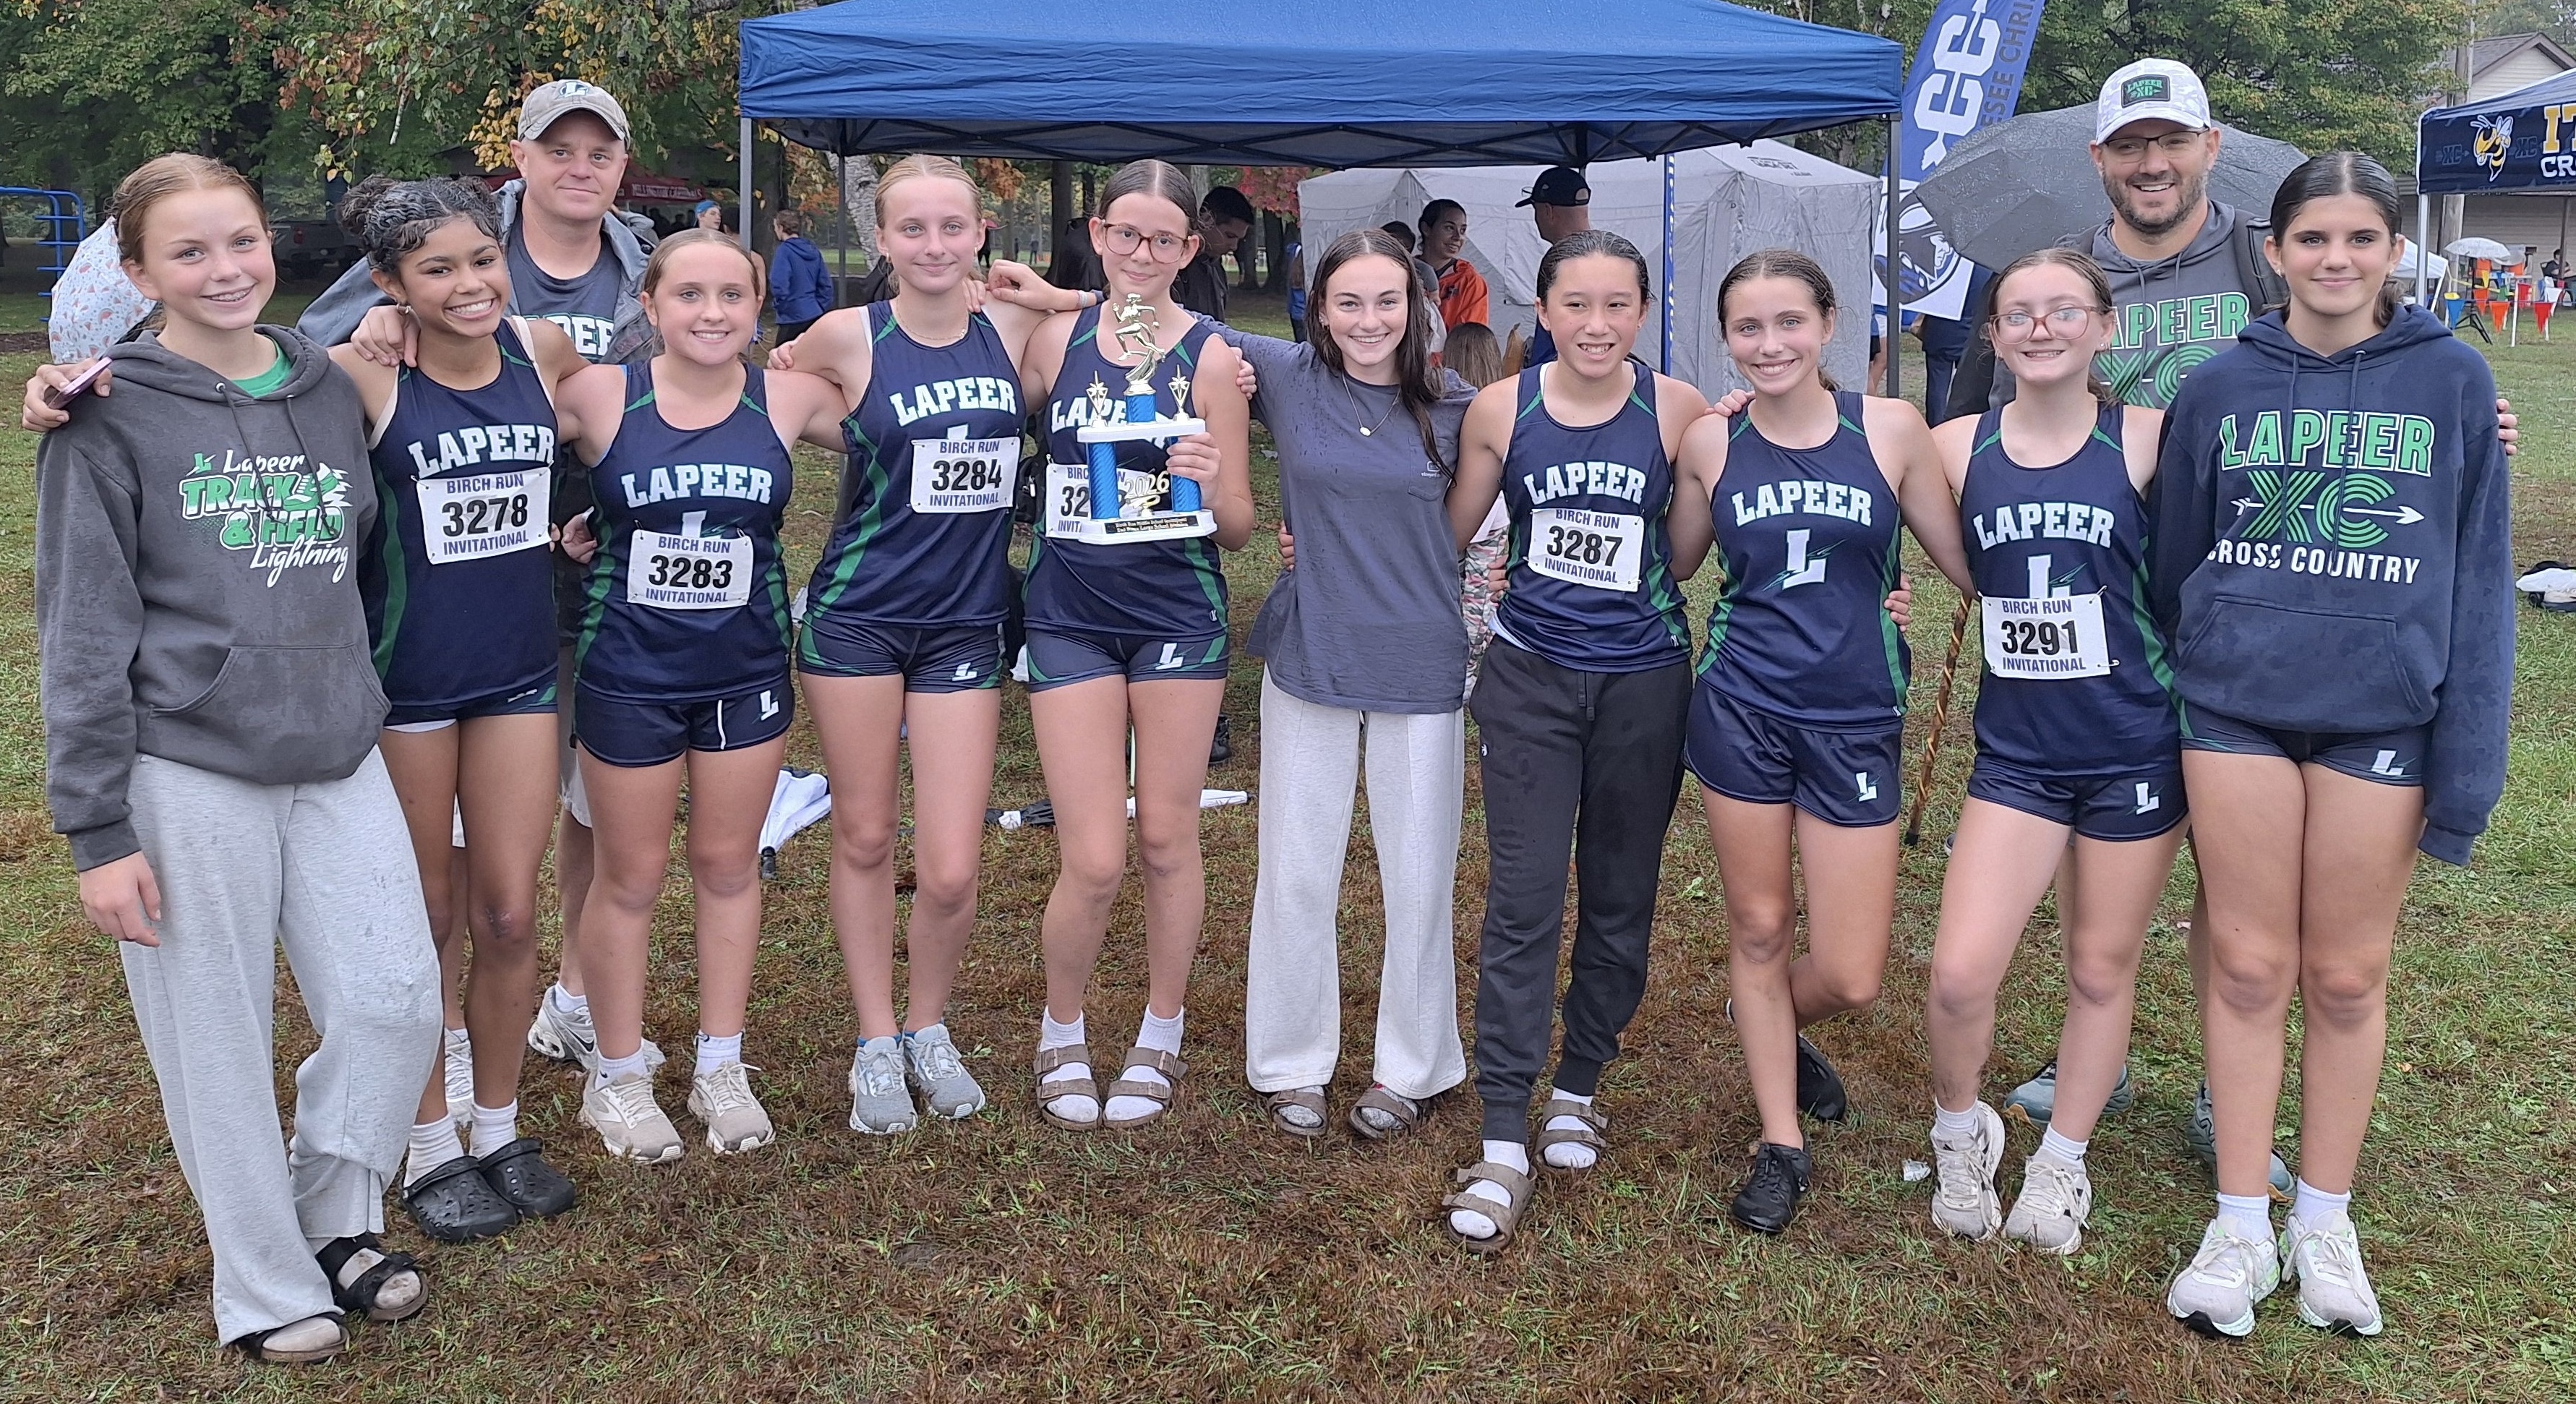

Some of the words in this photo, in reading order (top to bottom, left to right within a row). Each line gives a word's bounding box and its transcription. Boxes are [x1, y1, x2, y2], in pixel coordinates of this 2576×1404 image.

[2127, 79, 2162, 94] LAPEER
[2136, 85, 2153, 98] XC
[2541, 155, 2576, 178] CR
[889, 376, 1017, 427] LAPEER
[407, 424, 555, 479] LAPEER
[939, 441, 975, 454] BIRCH
[977, 440, 1000, 453] RUN
[2219, 409, 2435, 477] LAPEER
[223, 449, 305, 482] Lapeer
[931, 458, 1002, 491] 3284
[1067, 466, 1089, 479] BIRC
[179, 473, 301, 521] TRACK
[446, 477, 491, 495] BIRCH
[495, 473, 524, 489] RUN
[621, 463, 773, 508] LAPEER
[930, 492, 999, 507] INVITATIONAL
[1124, 470, 1170, 498] 2026
[1523, 461, 1647, 505] LAPEER
[442, 493, 529, 537] 3278
[1555, 508, 1590, 526] BIRCH
[1593, 514, 1620, 529] RUN
[1731, 479, 1873, 528] LAPEER
[2239, 470, 2396, 549] XC
[219, 508, 256, 551] &
[257, 506, 345, 548] FIELD
[444, 529, 529, 555] INVITATIONAL
[1973, 501, 2115, 552] LAPEER
[249, 534, 349, 588] Lightning
[658, 536, 698, 552] BIRCH
[703, 541, 731, 553] RUN
[1546, 525, 1623, 567] 3287
[1782, 528, 1827, 590] L
[648, 555, 733, 589] 3283
[1544, 557, 1618, 583] INVITATIONAL
[2290, 547, 2421, 584] COUNTRY
[646, 587, 729, 604] INVITATIONAL
[2002, 599, 2039, 615] BIRCH
[2042, 599, 2072, 614] RUN
[2001, 620, 2079, 656] 3291
[2002, 656, 2087, 672] INVITATIONAL
